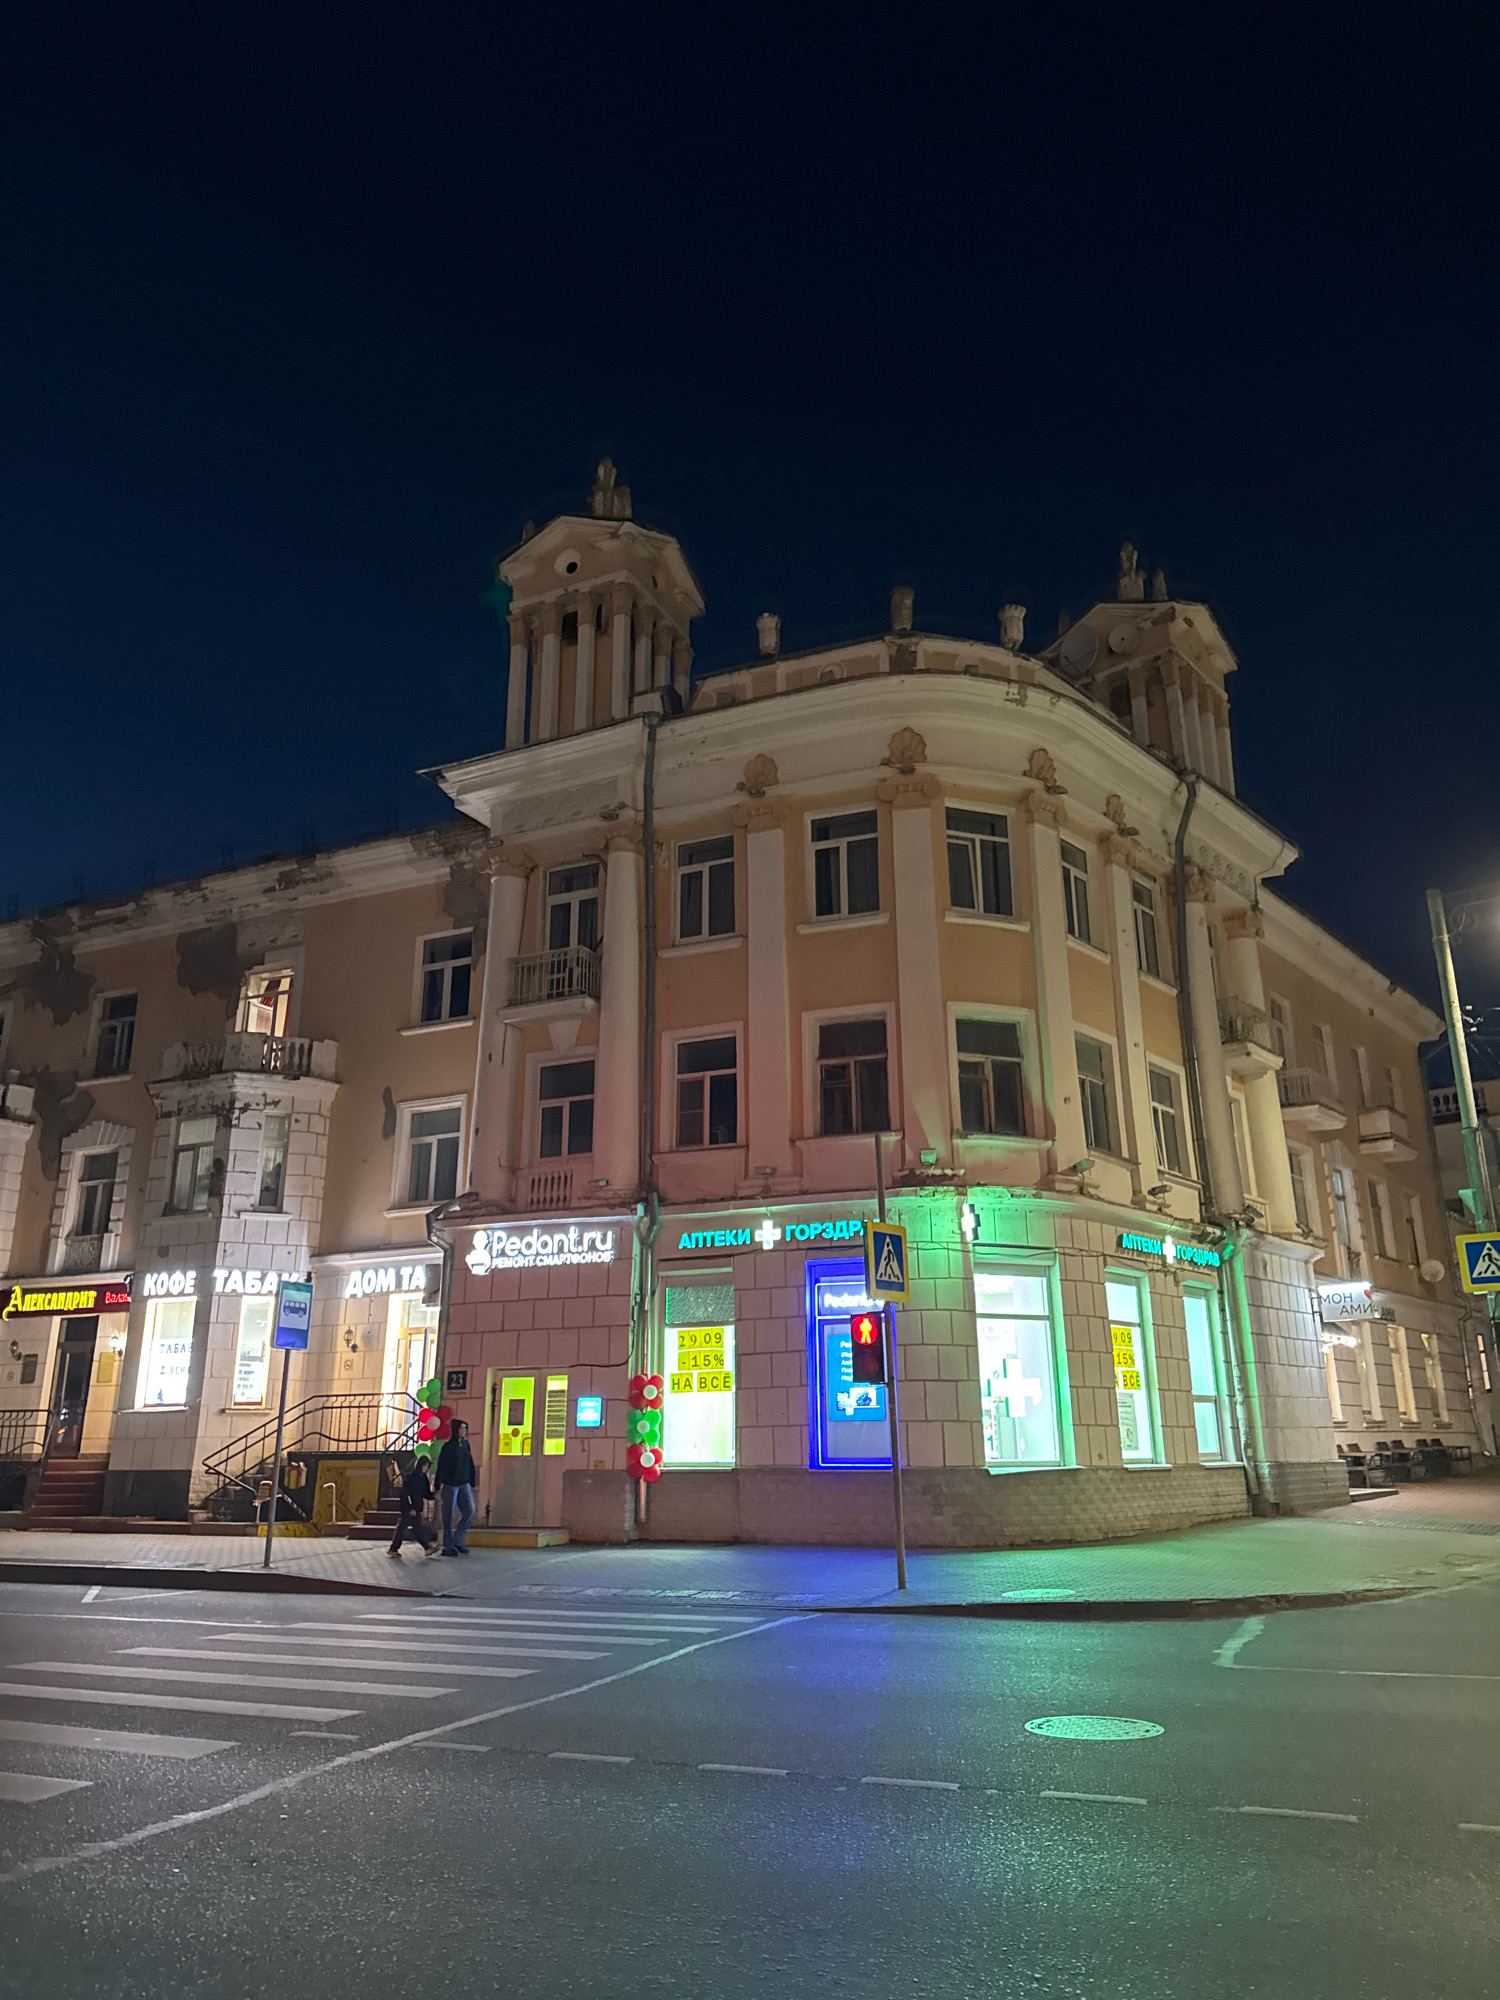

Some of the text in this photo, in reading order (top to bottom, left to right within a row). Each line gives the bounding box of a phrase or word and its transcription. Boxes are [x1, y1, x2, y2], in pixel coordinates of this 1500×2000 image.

[492, 1225, 615, 1257] Pedant.ru
[679, 1219, 879, 1250] АПТЕКИ ГОРЗДР
[1122, 1233, 1220, 1267] АПТЕКИ ГОРЗДРАВ
[536, 1251, 615, 1268] СМАРТФОНОВ
[143, 1270, 197, 1297] КОФЕ
[344, 1268, 396, 1299] ДОМ
[1321, 1292, 1353, 1305] МОН
[1340, 1303, 1373, 1316] АМИ
[681, 1354, 724, 1368] -15%
[450, 1374, 463, 1388] 23
[672, 1373, 731, 1391] НА ВСЁ
